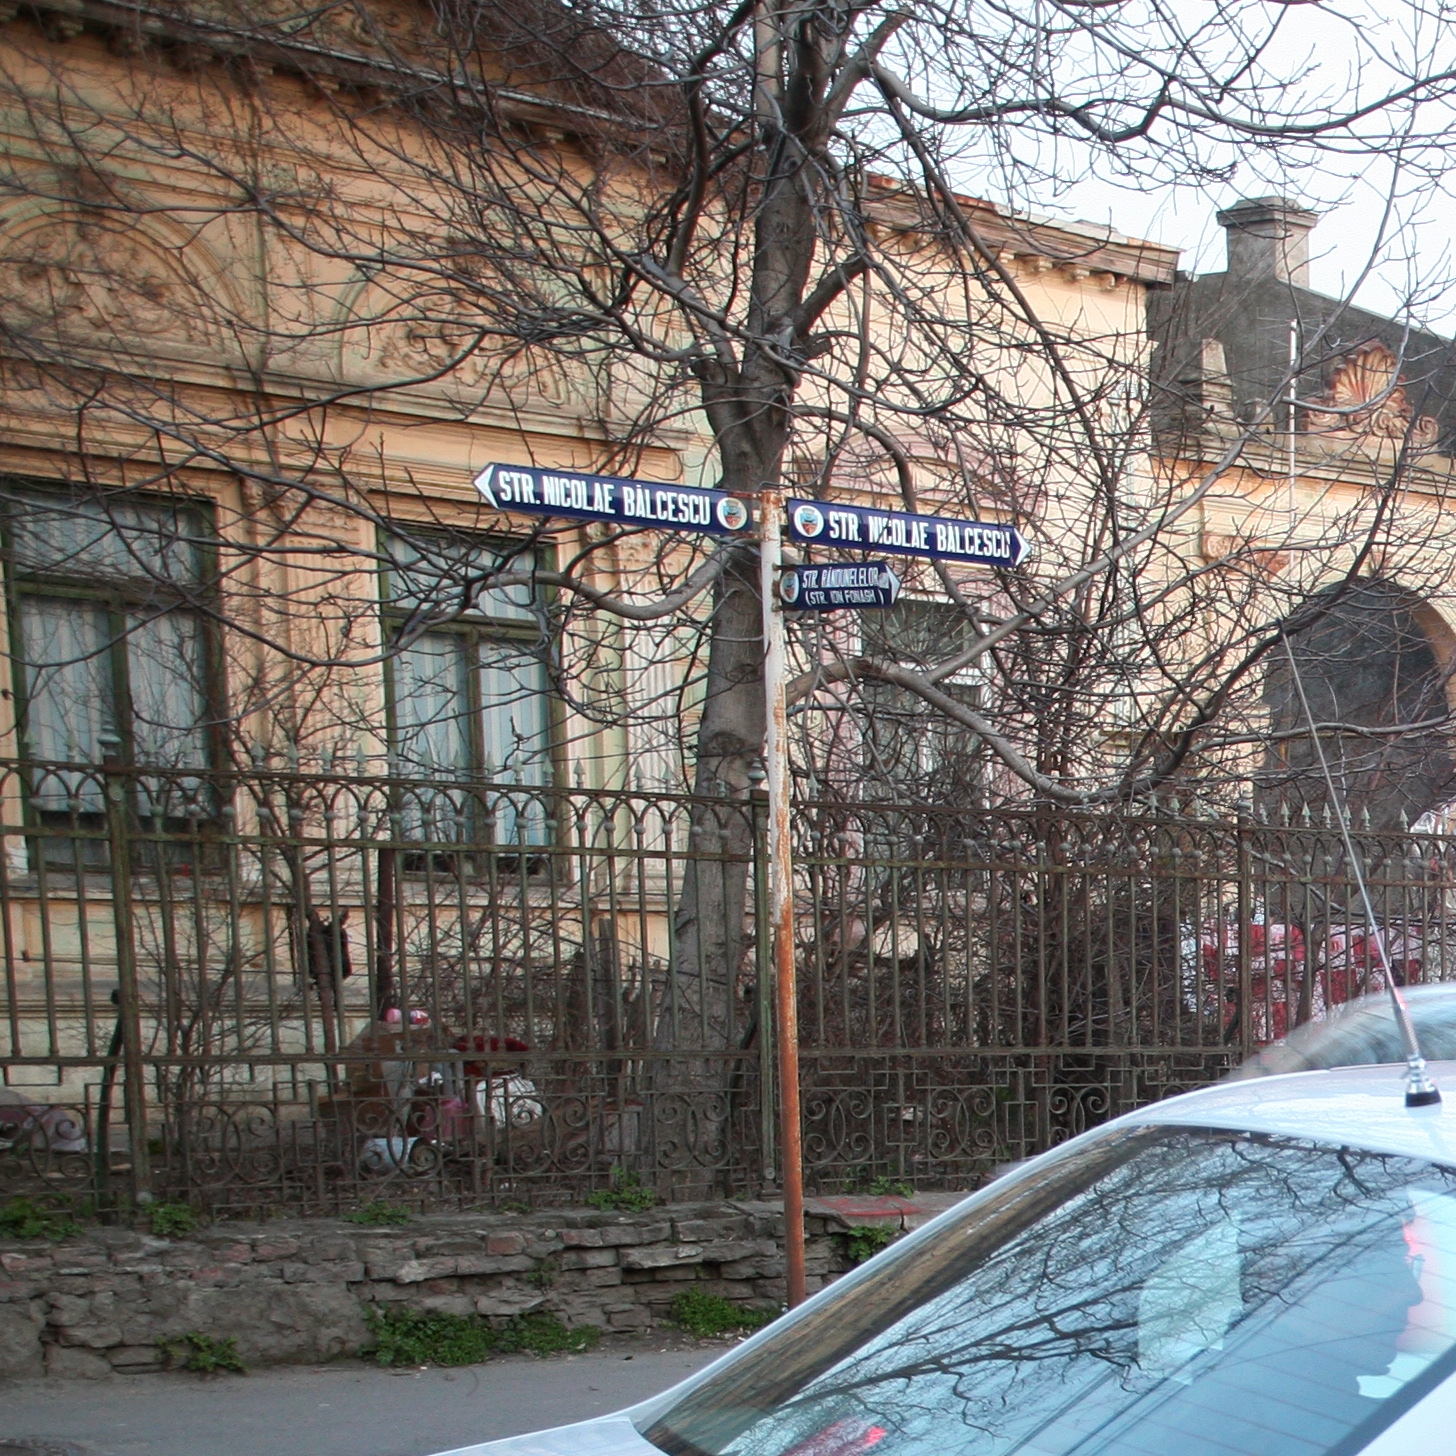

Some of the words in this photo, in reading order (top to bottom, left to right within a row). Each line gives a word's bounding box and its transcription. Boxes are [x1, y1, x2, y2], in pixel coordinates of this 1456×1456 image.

[498, 471, 541, 505] STR.
[542, 475, 616, 514] NICOLAE
[829, 511, 863, 542] STR.
[868, 515, 930, 551] NICOLAE
